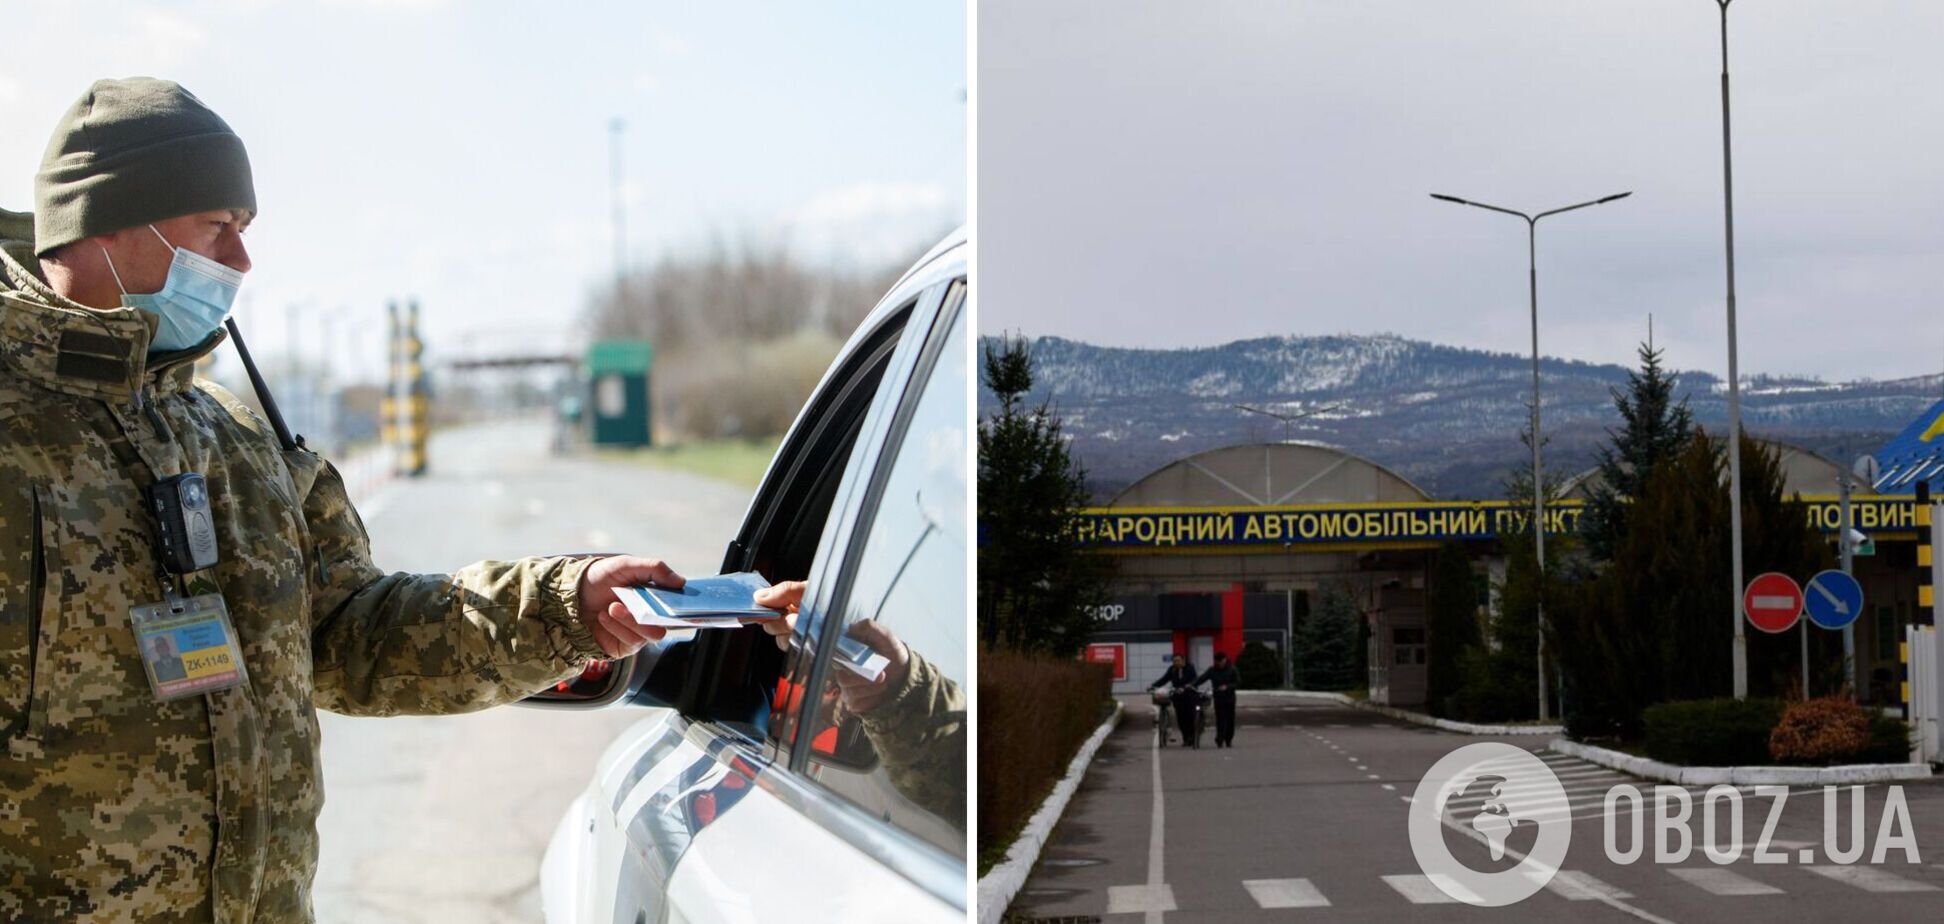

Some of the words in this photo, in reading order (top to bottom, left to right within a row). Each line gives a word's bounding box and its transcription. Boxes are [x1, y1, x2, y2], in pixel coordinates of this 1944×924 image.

[1066, 511, 1234, 545] НАРОДНИЙ
[1243, 503, 1487, 540] АВТОМОБІЛЬНИЙ
[1806, 502, 1917, 529] ЛОТВИН
